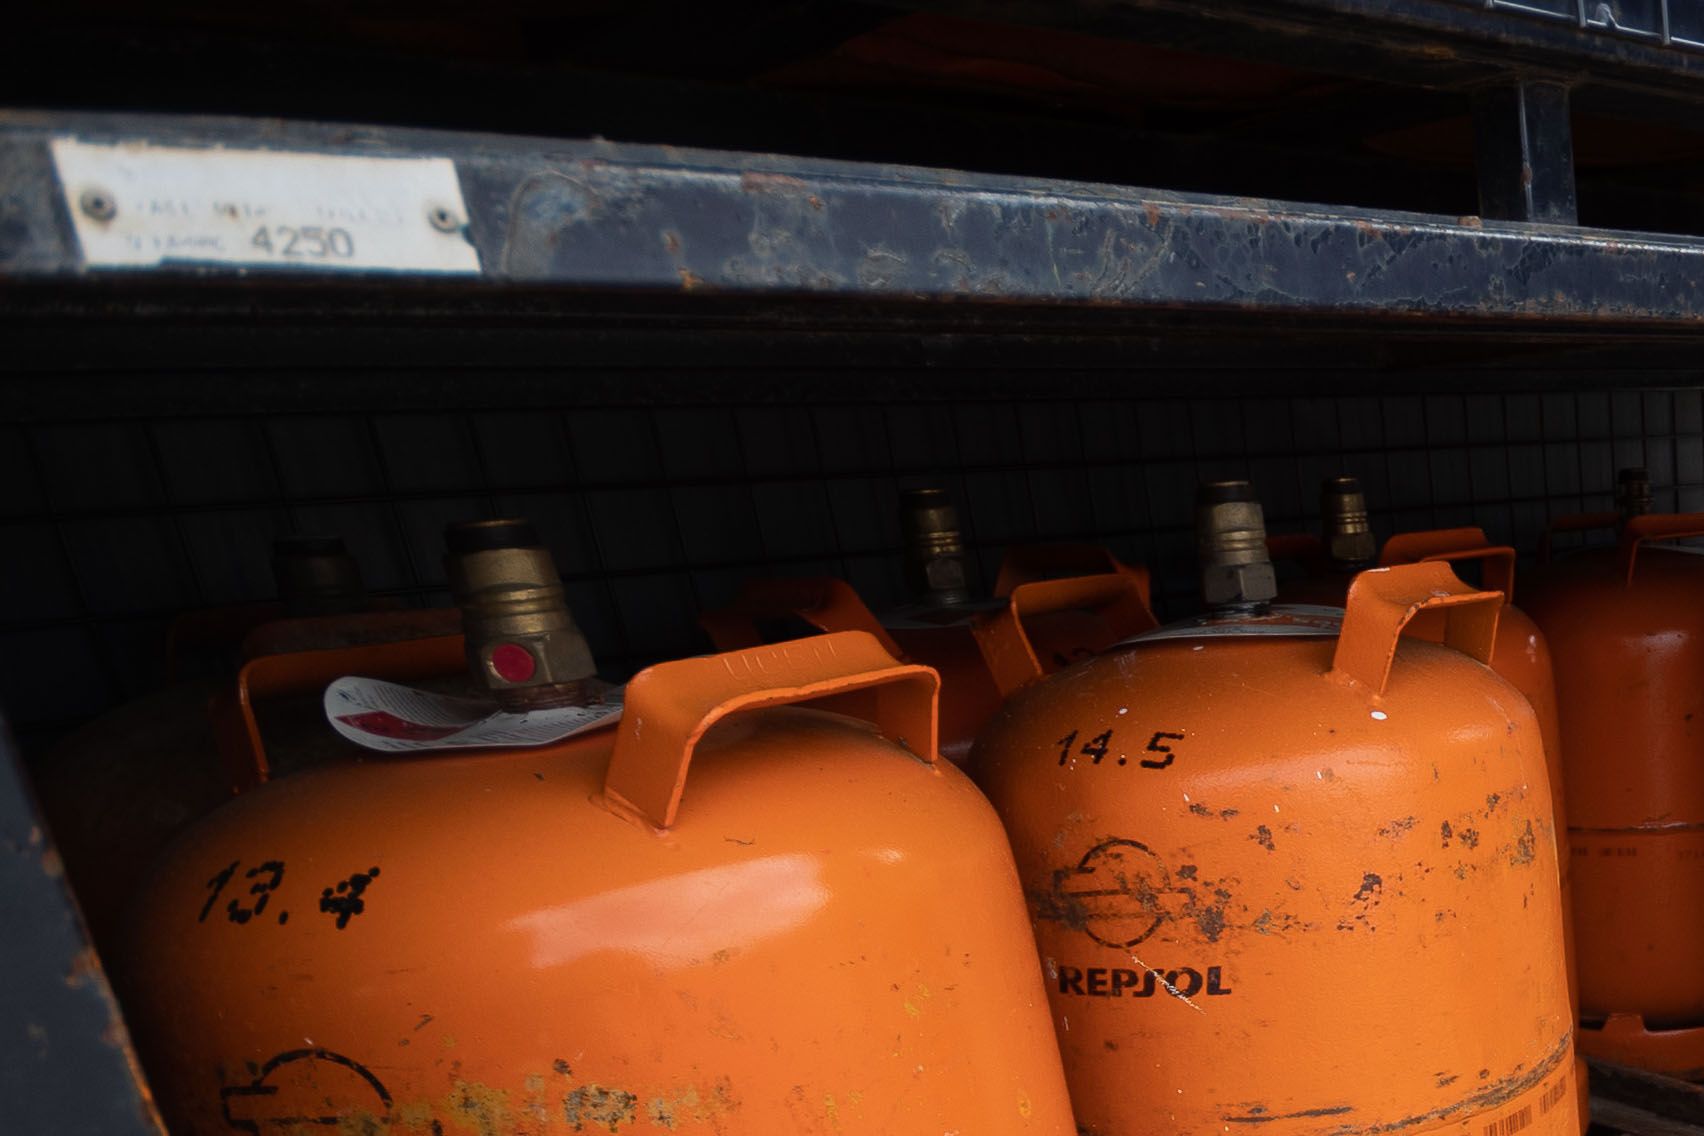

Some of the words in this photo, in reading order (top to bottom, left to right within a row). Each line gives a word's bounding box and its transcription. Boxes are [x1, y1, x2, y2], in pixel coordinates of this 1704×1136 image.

[248, 224, 355, 258] 4250
[1055, 728, 1187, 770] 14.5
[199, 859, 381, 930] 13.4
[1057, 965, 1233, 998] REPSOL
